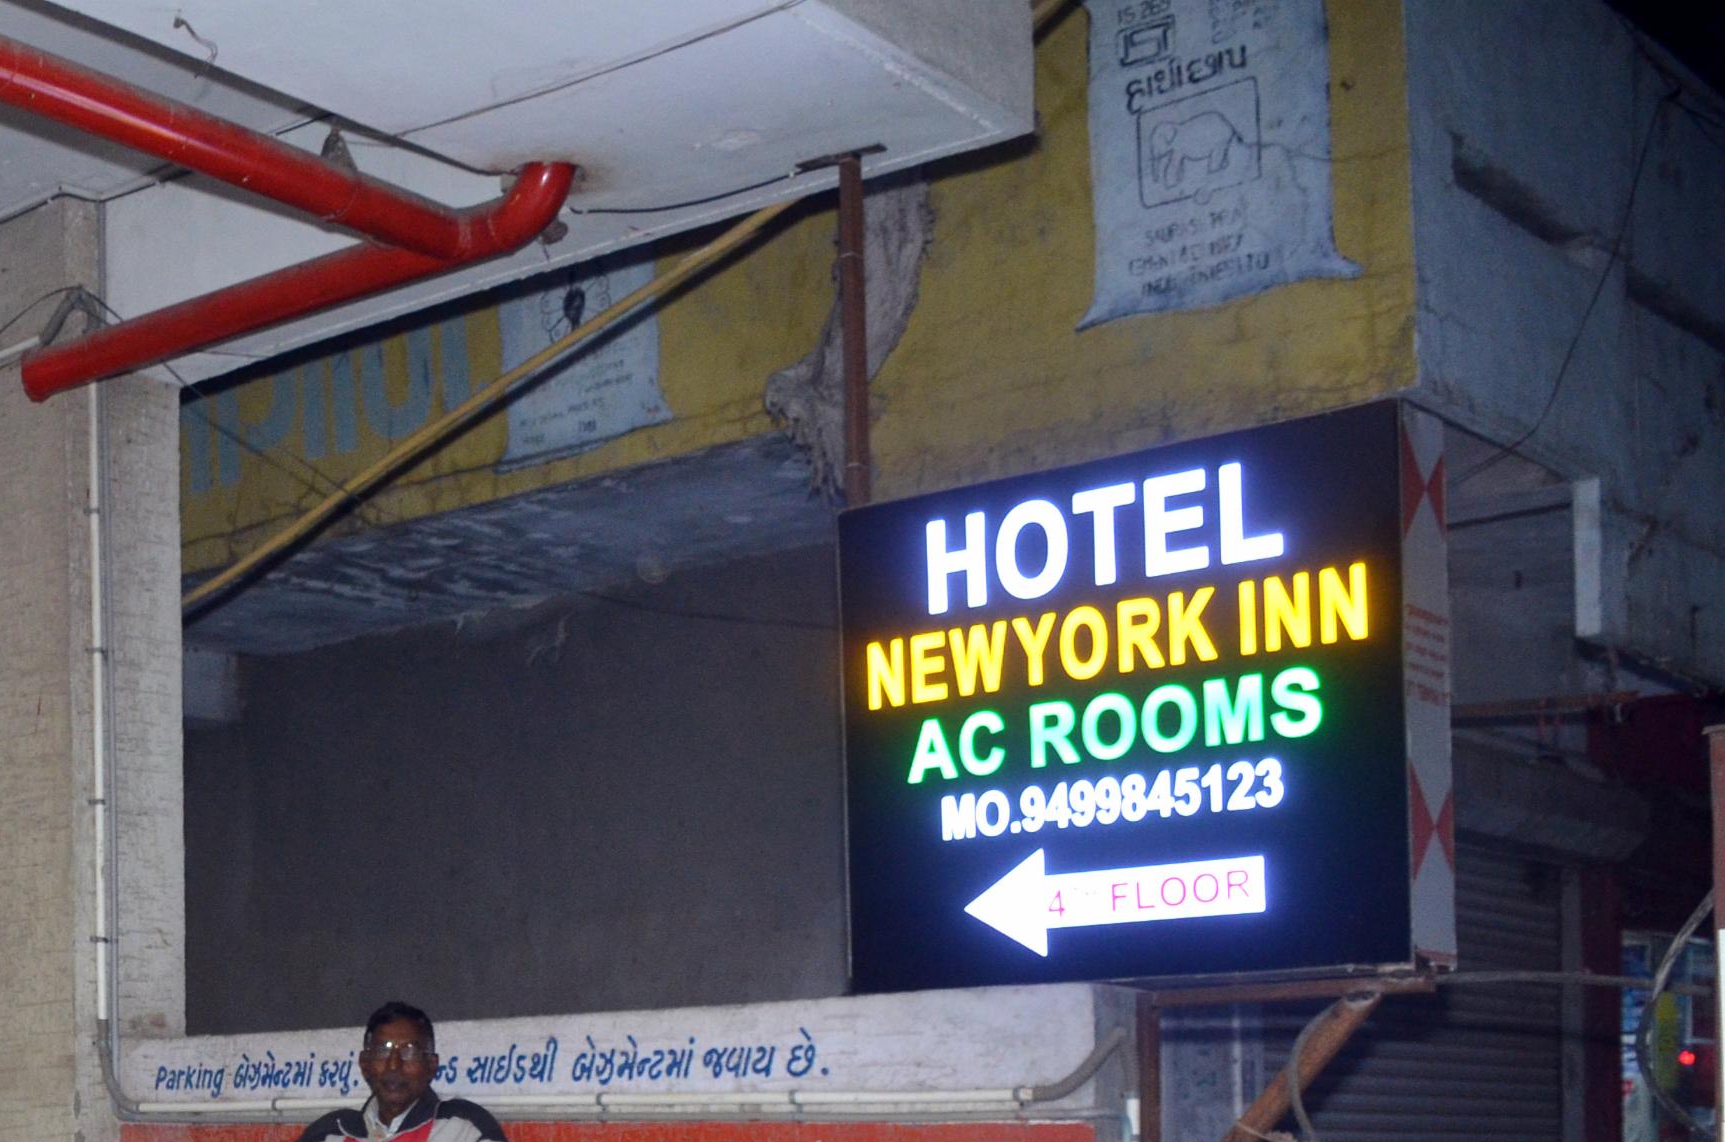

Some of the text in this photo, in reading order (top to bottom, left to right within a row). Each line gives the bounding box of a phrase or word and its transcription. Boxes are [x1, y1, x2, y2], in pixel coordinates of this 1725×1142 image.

[924, 460, 1285, 615] HOTEL
[1237, 561, 1371, 656] INN
[906, 665, 1324, 784] AC ROOMS
[1111, 869, 1250, 912] FLOOR
[155, 1065, 225, 1098] Parking
[703, 1045, 777, 1078] જવાય
